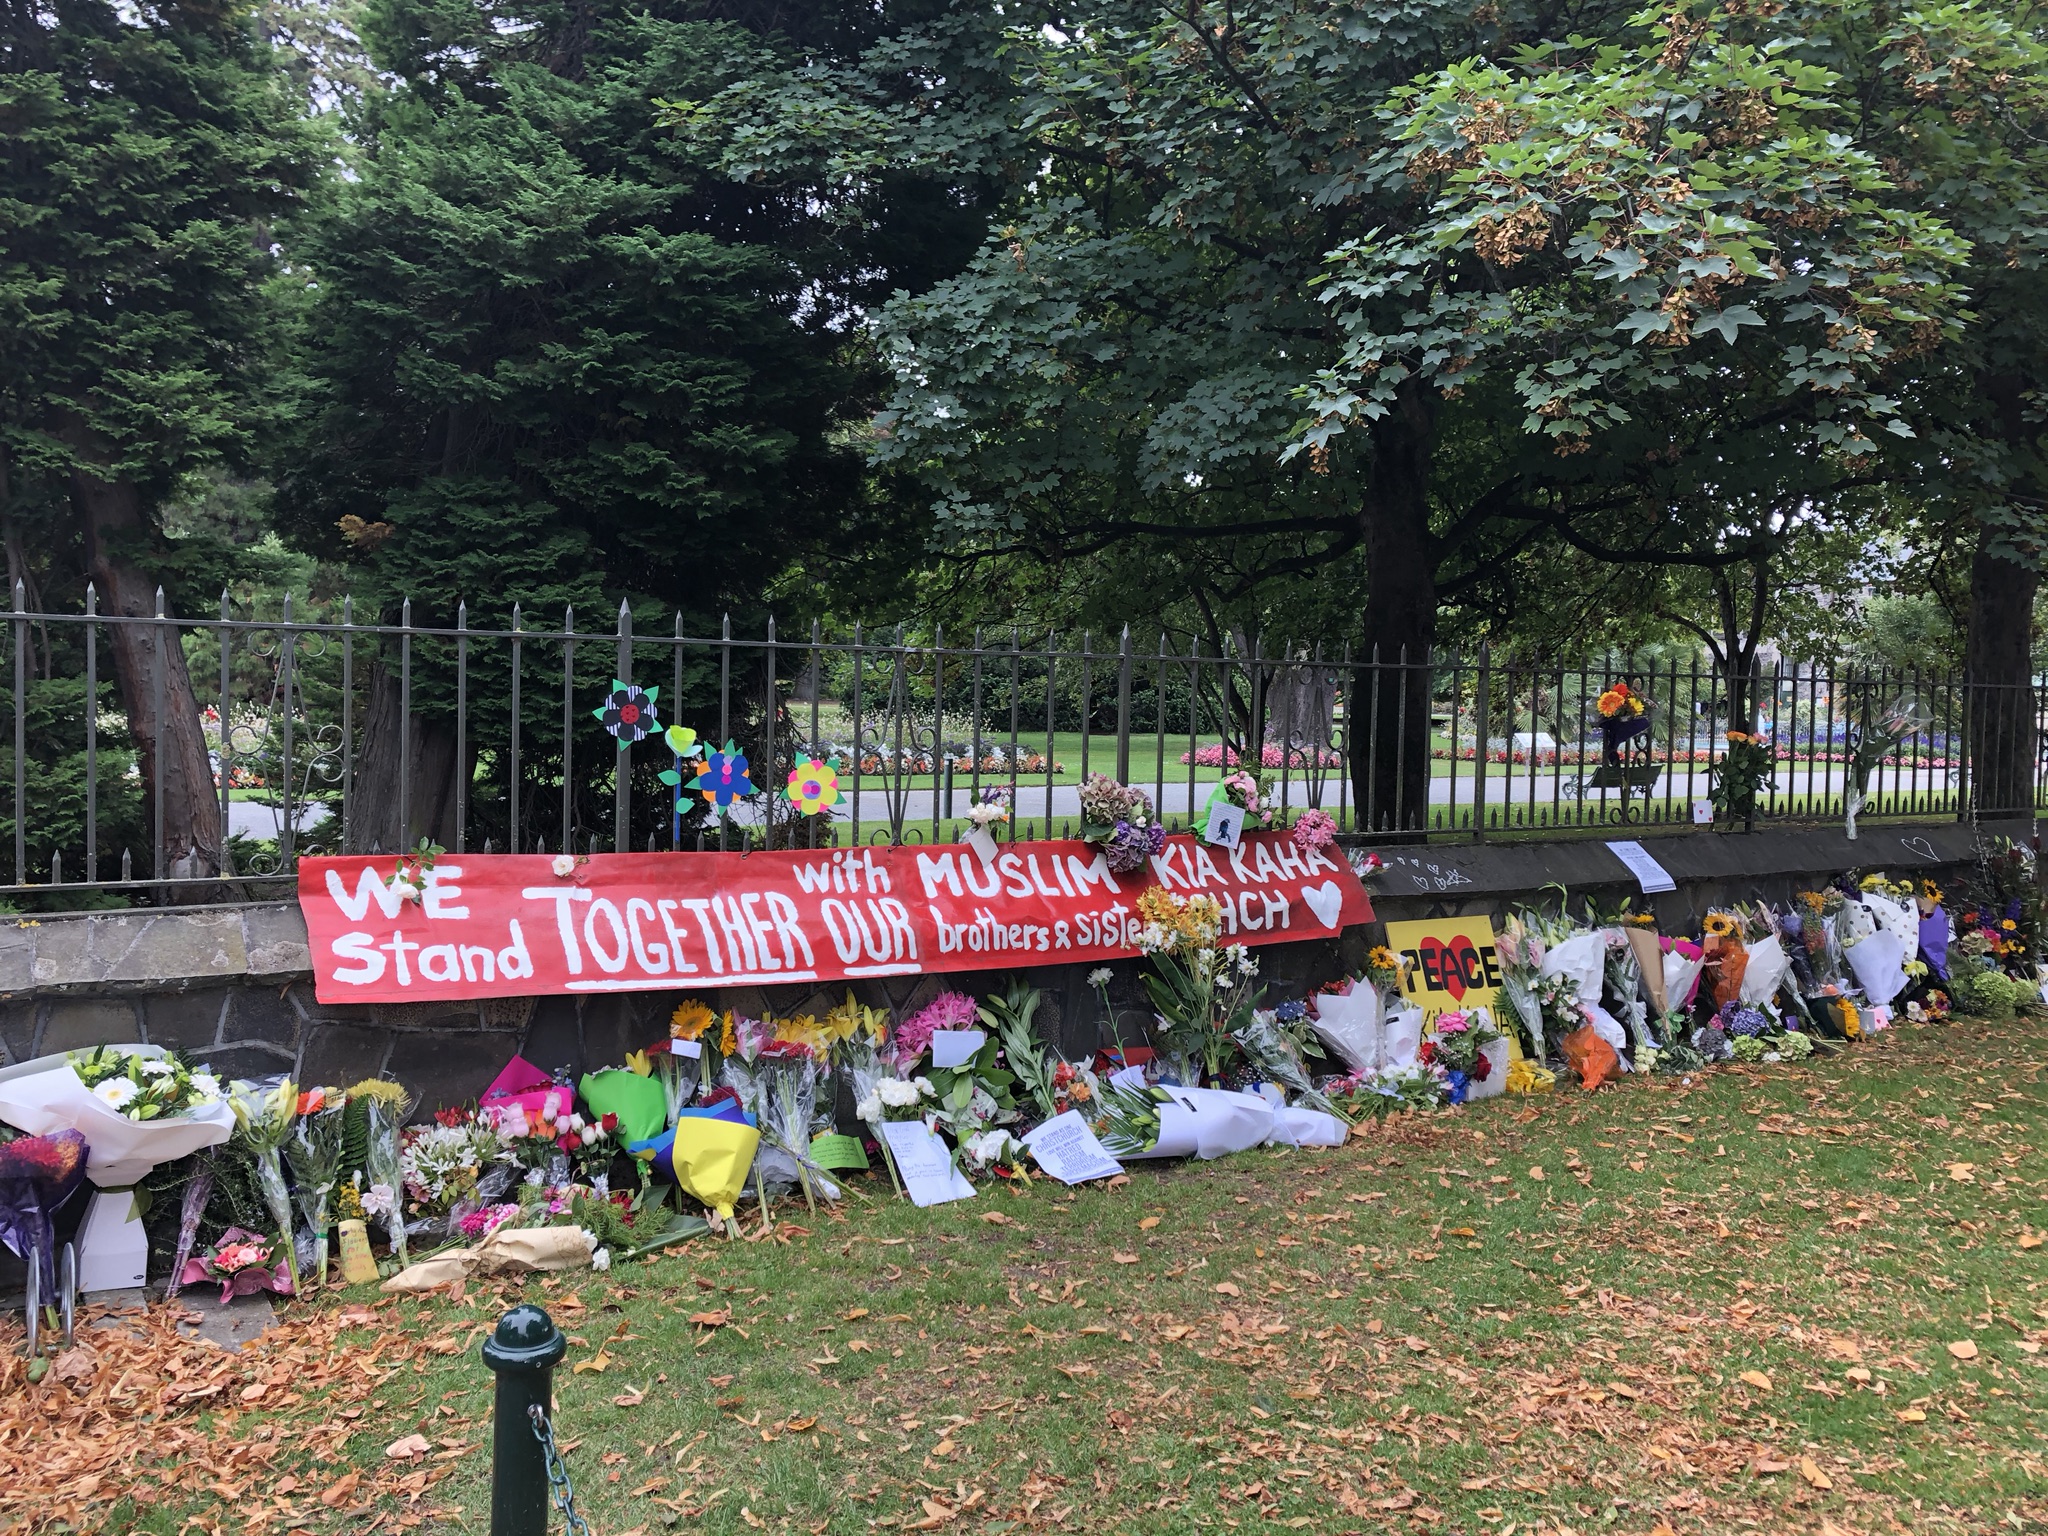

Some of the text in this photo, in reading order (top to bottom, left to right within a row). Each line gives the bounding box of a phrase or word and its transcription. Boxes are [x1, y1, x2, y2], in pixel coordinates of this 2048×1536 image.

[792, 850, 891, 891] with
[916, 851, 1121, 901] MUSLIM
[1150, 841, 1339, 890] KIA KAHA
[325, 865, 470, 921] WE
[1189, 889, 1291, 934] HCH
[331, 886, 815, 987] Stand TOGETHER
[821, 897, 918, 963] OUR
[930, 904, 1050, 954] brothers
[1055, 921, 1072, 950] &
[1400, 946, 1503, 993] PEACE
[1035, 1125, 1083, 1153] CHRISTCHURCH
[1056, 1143, 1082, 1160] HATRED
[1060, 1150, 1088, 1167] RACISM
